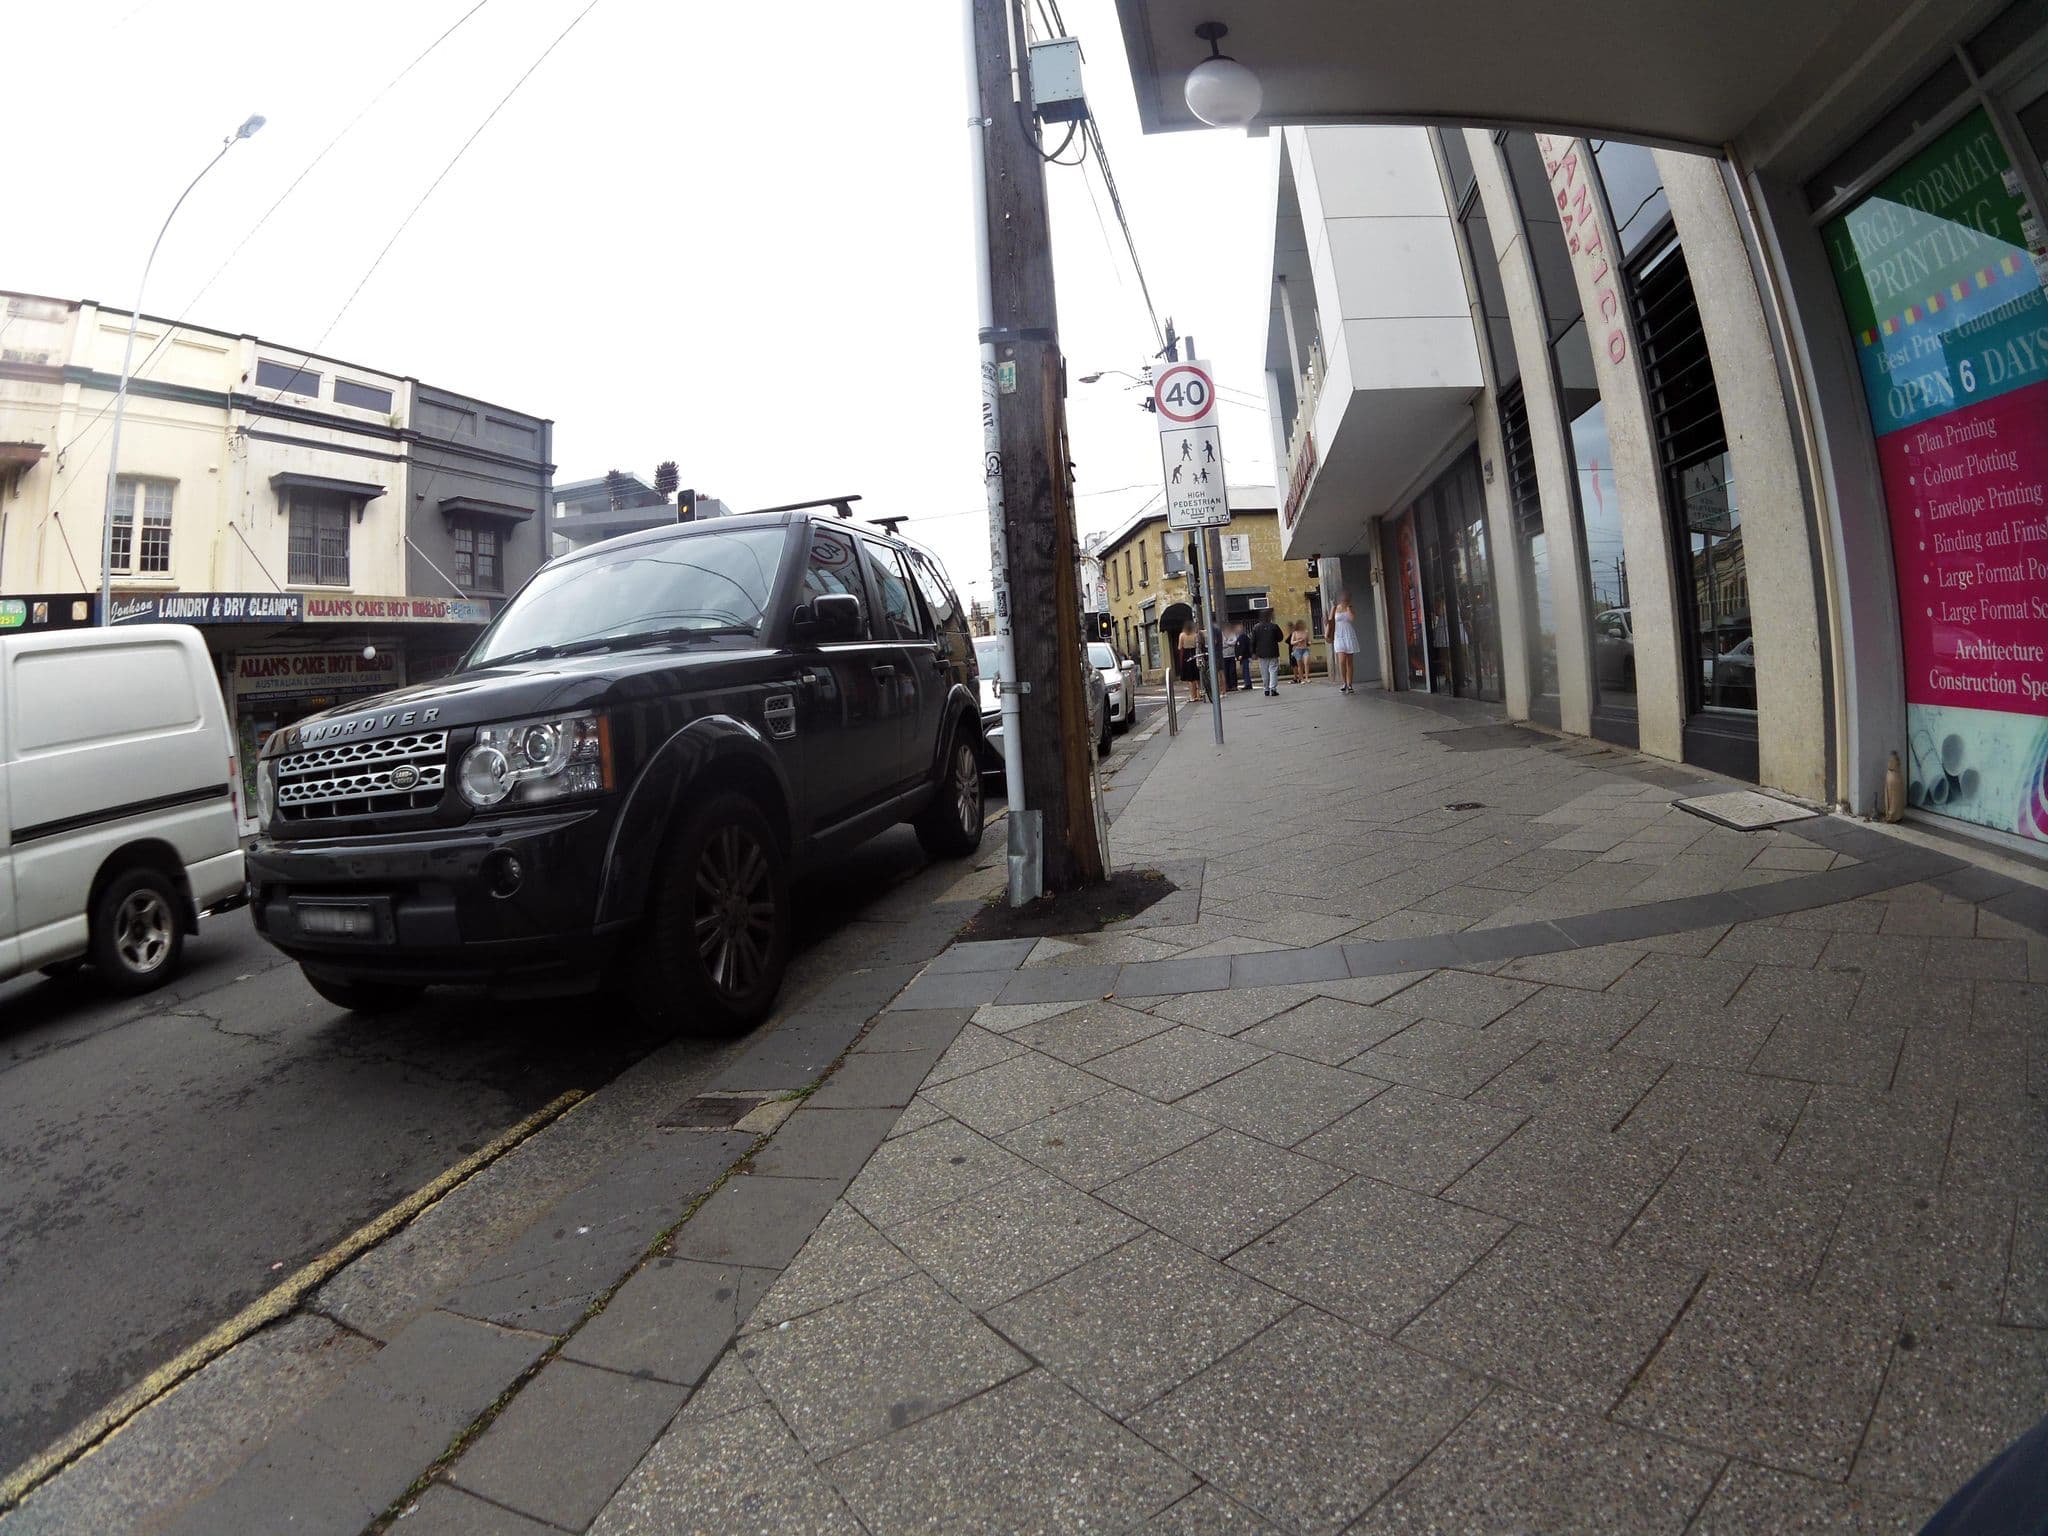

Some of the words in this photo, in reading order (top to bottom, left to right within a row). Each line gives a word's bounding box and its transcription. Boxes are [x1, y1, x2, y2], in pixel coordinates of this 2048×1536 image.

[1834, 202, 1901, 272] LARGE
[1902, 132, 2003, 227] FORMAT
[1561, 153, 1626, 365] ANTICO
[1864, 199, 2001, 306] PRINTING
[1876, 340, 1910, 375] Best
[1911, 330, 1952, 364] Price
[1954, 288, 2042, 338] Guarantee
[1887, 367, 1956, 419] OPEN
[1959, 359, 1977, 393] 6
[1982, 325, 2048, 386] DAYS
[1165, 380, 1205, 407] 40
[1917, 433, 1944, 455] Plan
[1945, 416, 1997, 447] Printing
[1923, 463, 1964, 486] Colour
[1966, 449, 2019, 478] Plotting
[1173, 498, 1222, 508] PEDESTRIAN
[1187, 491, 1206, 499] HIGH
[1928, 494, 1985, 521] Envelope
[1987, 482, 2044, 507] Printing
[1180, 507, 1216, 516] ACTIVITY
[1934, 529, 1983, 554] Binding
[1985, 522, 2010, 547] and
[2012, 517, 2048, 544] Finis
[1938, 565, 1974, 591] Large
[1976, 561, 2025, 585] Format
[158, 598, 209, 618] LAUNDRY
[212, 597, 222, 617] &
[223, 597, 246, 617] DRY
[249, 597, 298, 617] CLEANING
[307, 599, 353, 617] ALLAN'S
[355, 600, 385, 617] CAKE
[387, 600, 410, 617] HOT
[1942, 601, 1977, 625] Large
[1979, 597, 2029, 621] Format
[1955, 638, 2044, 663] Architecture
[240, 656, 290, 678] ALLAN'S
[295, 655, 326, 675] CAKE
[328, 654, 351, 673] HOT
[1929, 668, 2017, 696] Construction
